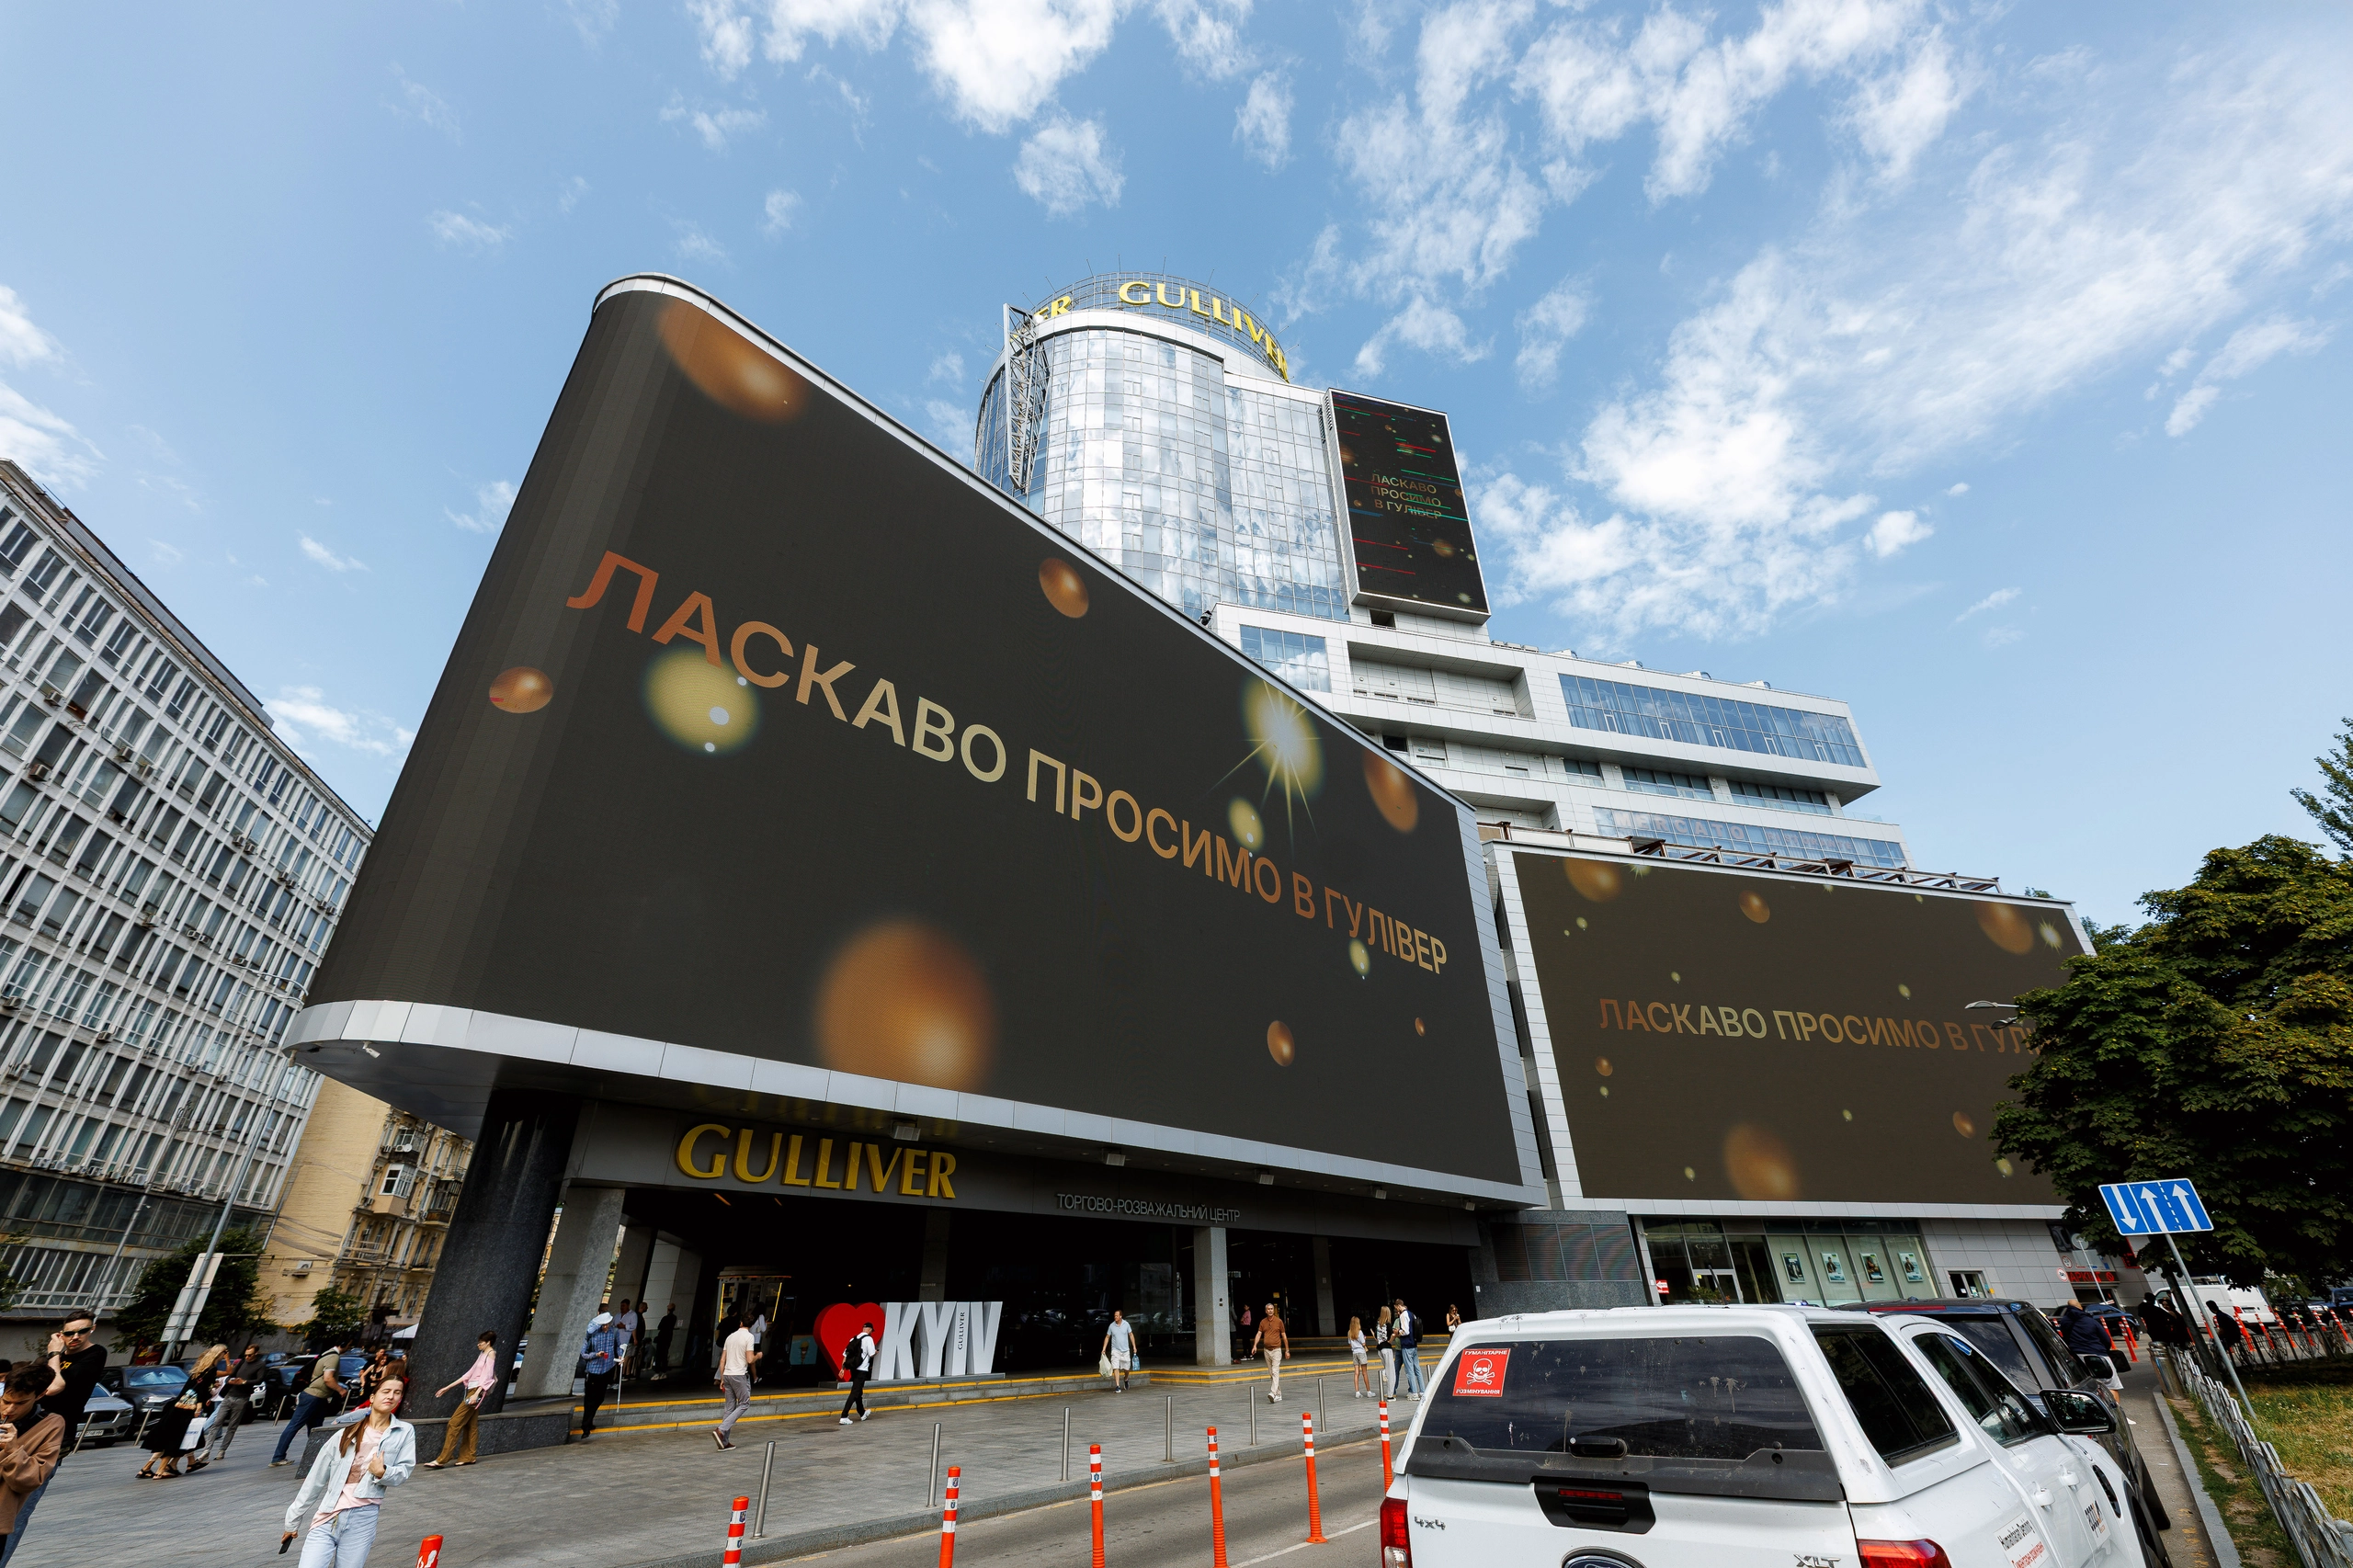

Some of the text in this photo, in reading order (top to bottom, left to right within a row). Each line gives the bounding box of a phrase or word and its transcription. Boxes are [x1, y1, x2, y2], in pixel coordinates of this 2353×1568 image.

[1118, 280, 1290, 384] GULLIVER
[1370, 472, 1437, 494] ЛАСКАВО
[1370, 485, 1442, 507] ПРОСИМО
[1373, 498, 1384, 509] В
[565, 550, 1448, 974] ЛАСКАВО ПРОСИМО В ГУЛІВЕР
[1613, 810, 1745, 840] MERCATO
[1599, 998, 1767, 1040] ЛАСКАВО
[1772, 1009, 1940, 1050] ПРОСИМО
[1943, 1021, 1970, 1051] В
[676, 1123, 957, 1199] GULLIVER
[1057, 1193, 1241, 1223] ТОРГОВО-РОЗВАЖАЛЬНИЙ ЦЕНТР
[2067, 1271, 2102, 1282] АРКІГ
[873, 1301, 1003, 1381] KYIV
[957, 1311, 966, 1350] GULLIVER
[1792, 1553, 1842, 1568] XLT
